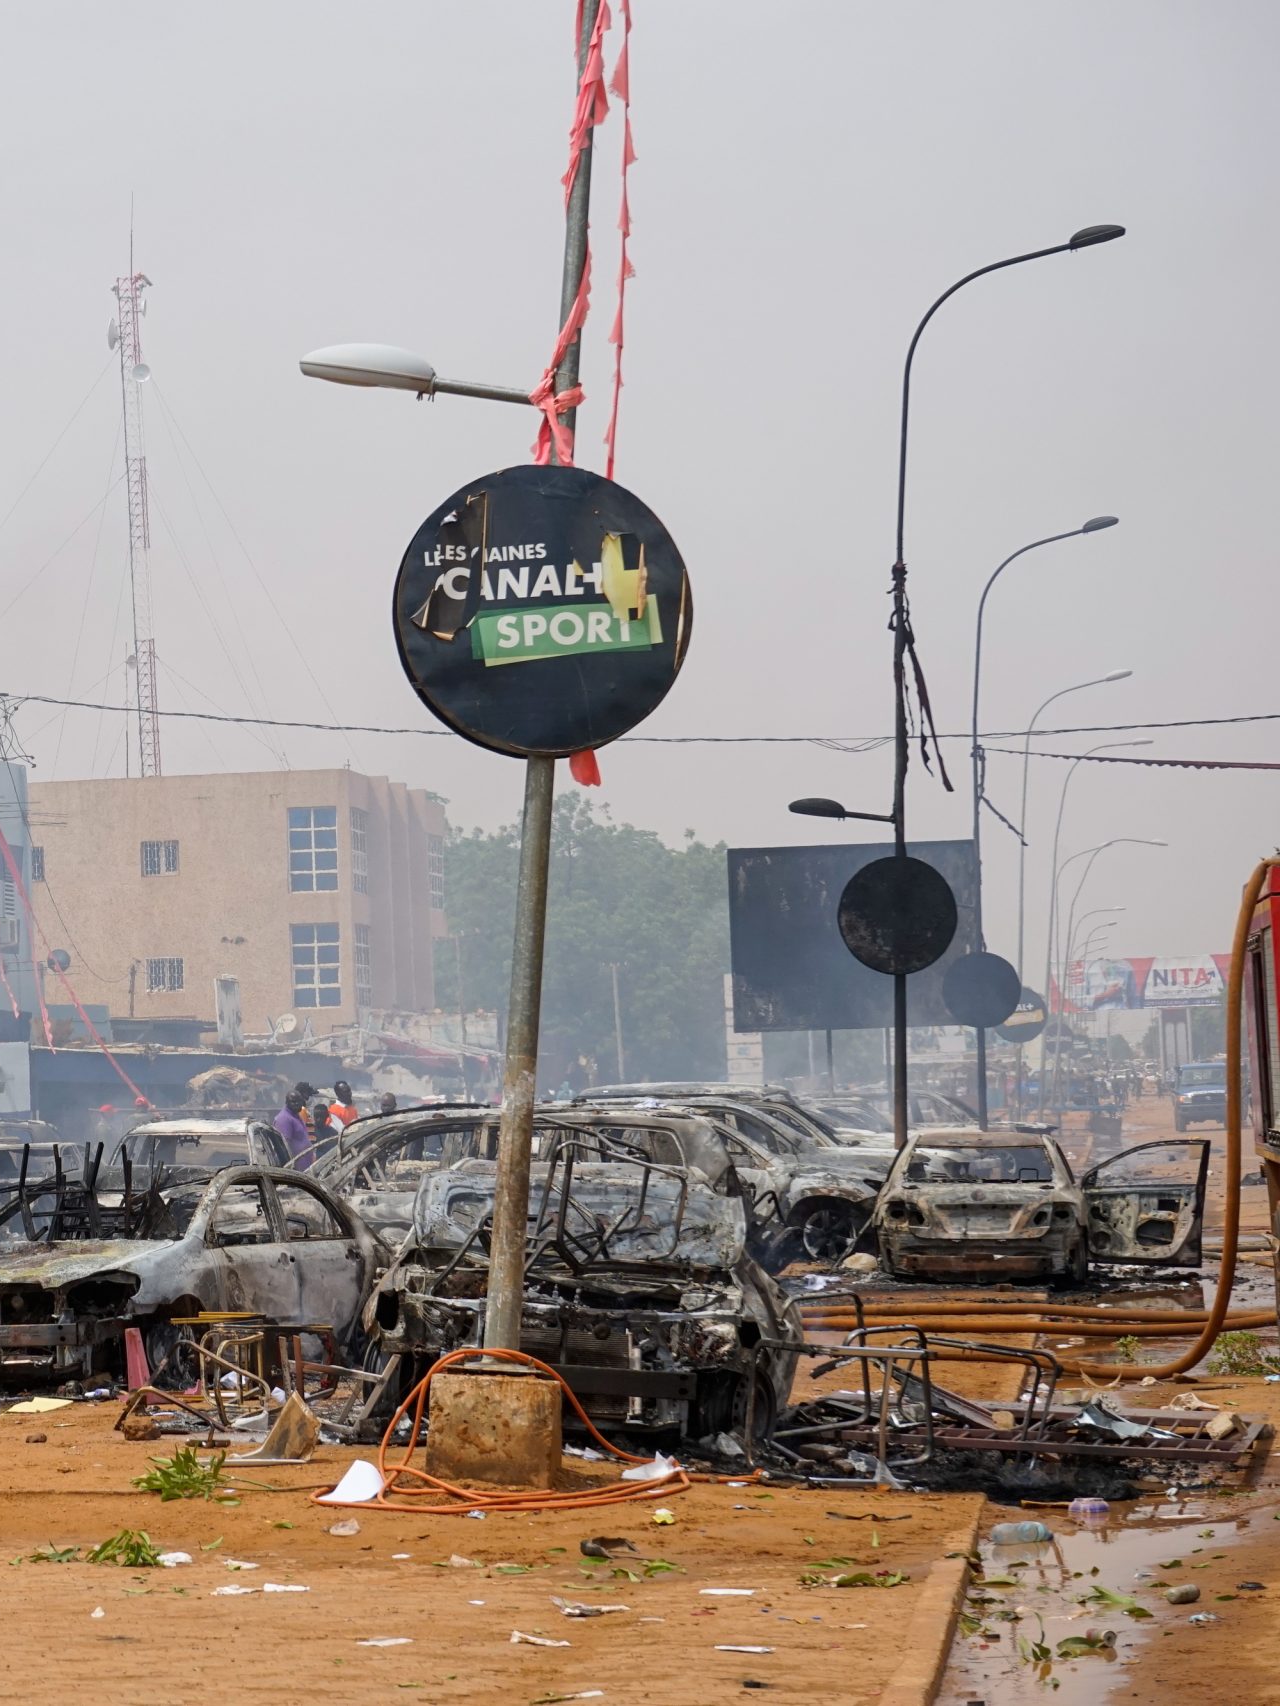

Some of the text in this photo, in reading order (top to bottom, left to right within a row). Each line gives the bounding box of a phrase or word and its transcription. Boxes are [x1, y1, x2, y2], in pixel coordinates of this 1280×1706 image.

[471, 543, 547, 563] AINES
[497, 611, 632, 648] SPORT
[1152, 967, 1211, 987] NITA
